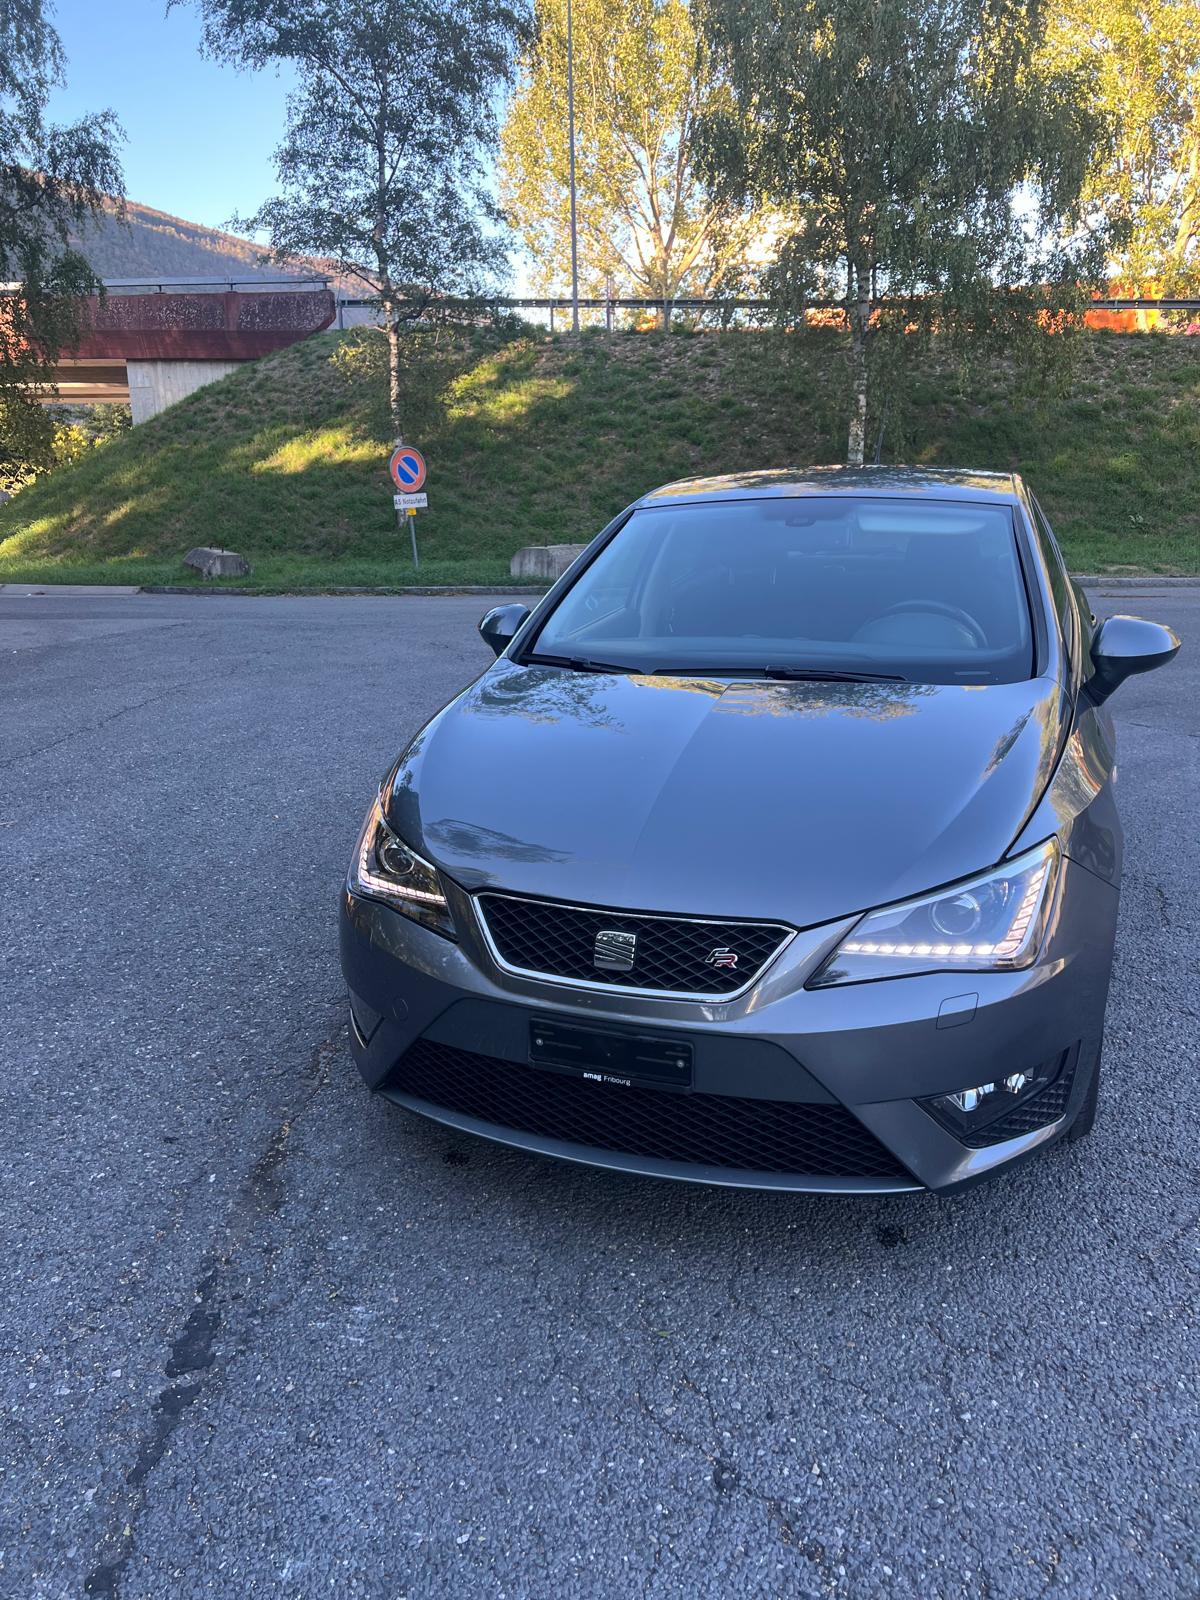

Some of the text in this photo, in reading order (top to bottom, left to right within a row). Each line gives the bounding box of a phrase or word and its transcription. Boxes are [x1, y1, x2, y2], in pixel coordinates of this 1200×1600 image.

[704, 947, 739, 969] FR
[583, 1072, 631, 1086] amag Fribourg
